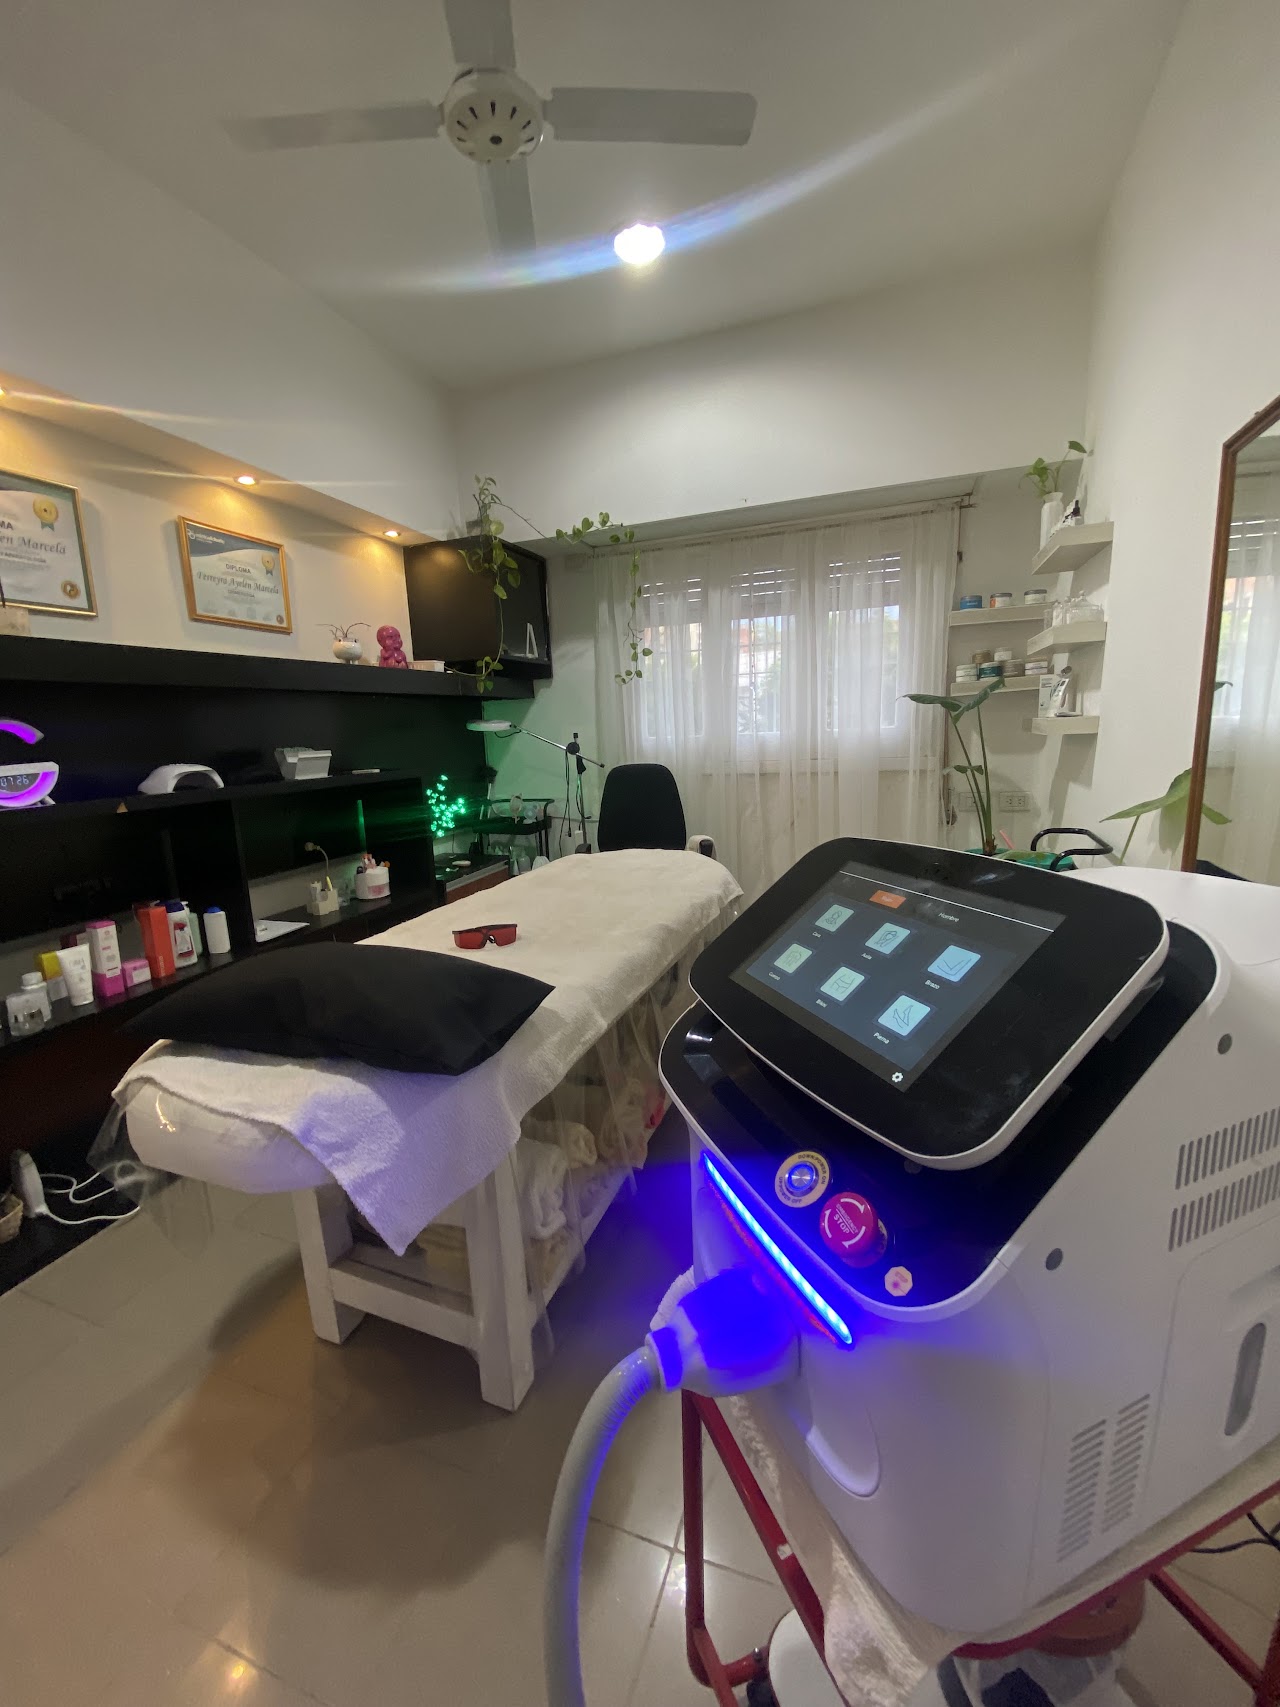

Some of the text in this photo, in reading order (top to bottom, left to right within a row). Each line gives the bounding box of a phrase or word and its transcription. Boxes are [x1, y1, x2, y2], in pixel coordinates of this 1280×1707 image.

[19, 536, 66, 554] Marcela
[225, 563, 251, 574] DIPLOMA
[253, 582, 279, 594] Marcela
[938, 912, 960, 923] Hombre
[924, 979, 941, 990] Brazo
[833, 1213, 850, 1234] STOP
[836, 1203, 858, 1233] EMERGENCY
